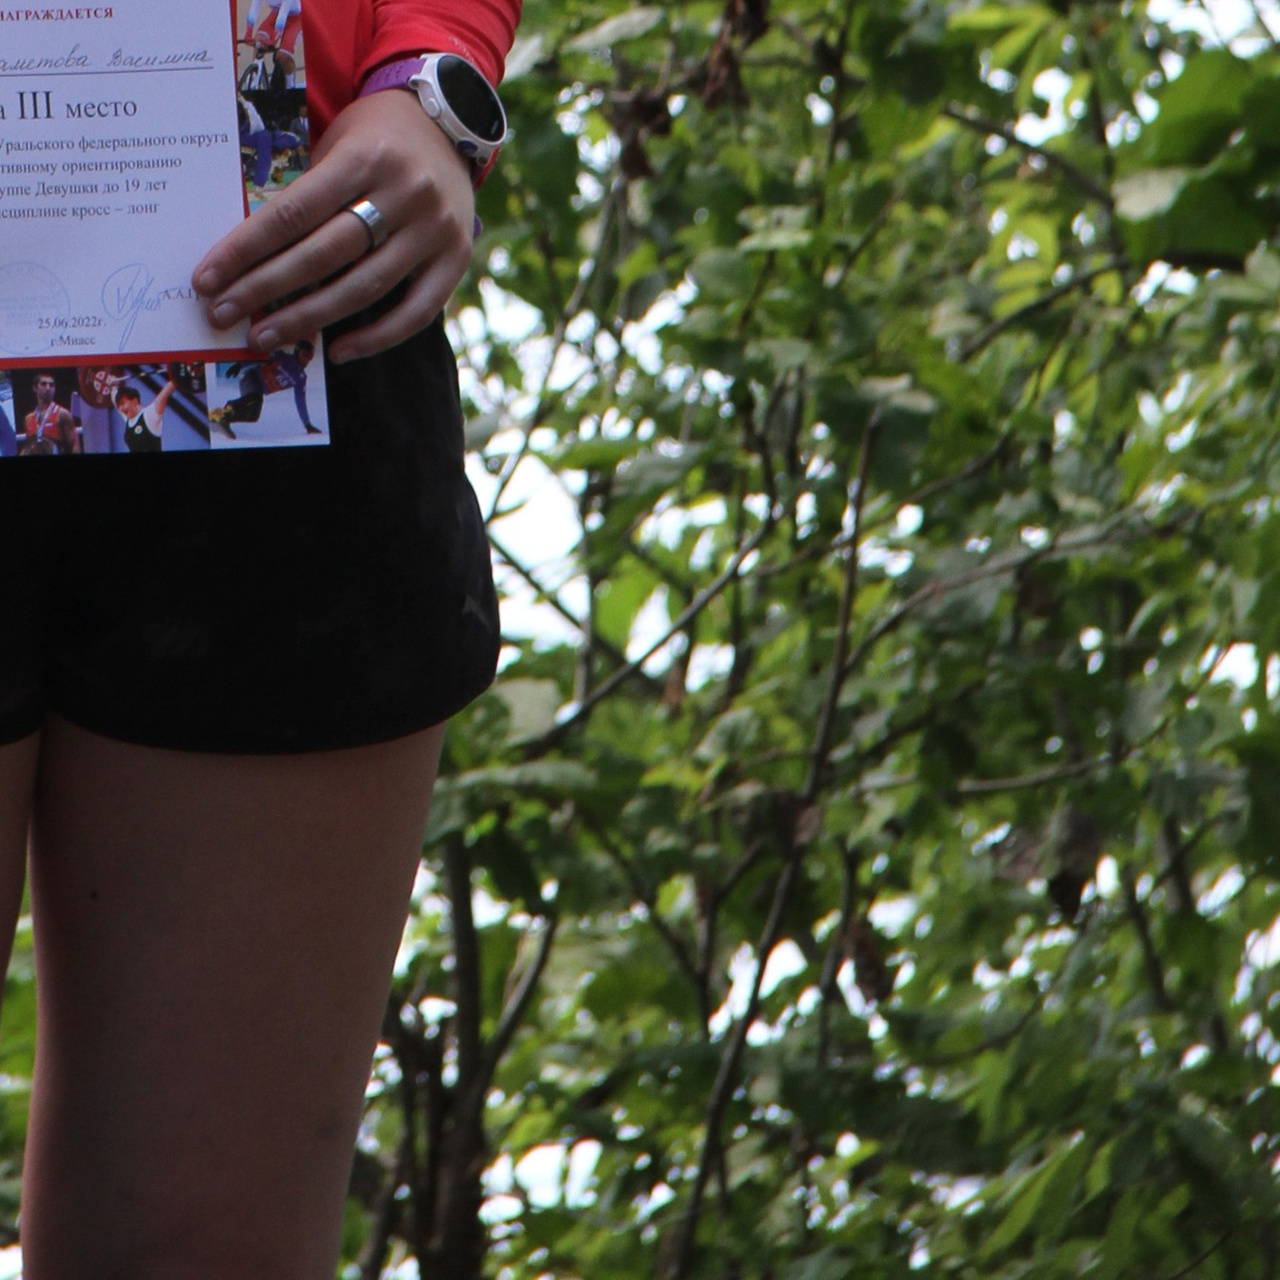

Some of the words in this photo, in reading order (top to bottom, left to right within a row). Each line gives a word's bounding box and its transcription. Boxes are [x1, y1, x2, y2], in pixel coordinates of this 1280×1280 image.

[65, 99, 137, 119] место
[78, 133, 177, 151] федерального
[180, 132, 229, 146] округа
[62, 156, 182, 175] ориентированию
[35, 181, 99, 197] Девушки
[102, 182, 120, 196] до
[124, 178, 140, 192] 19
[143, 180, 168, 192] лет
[72, 204, 110, 220] кросс
[127, 202, 160, 215] лонг
